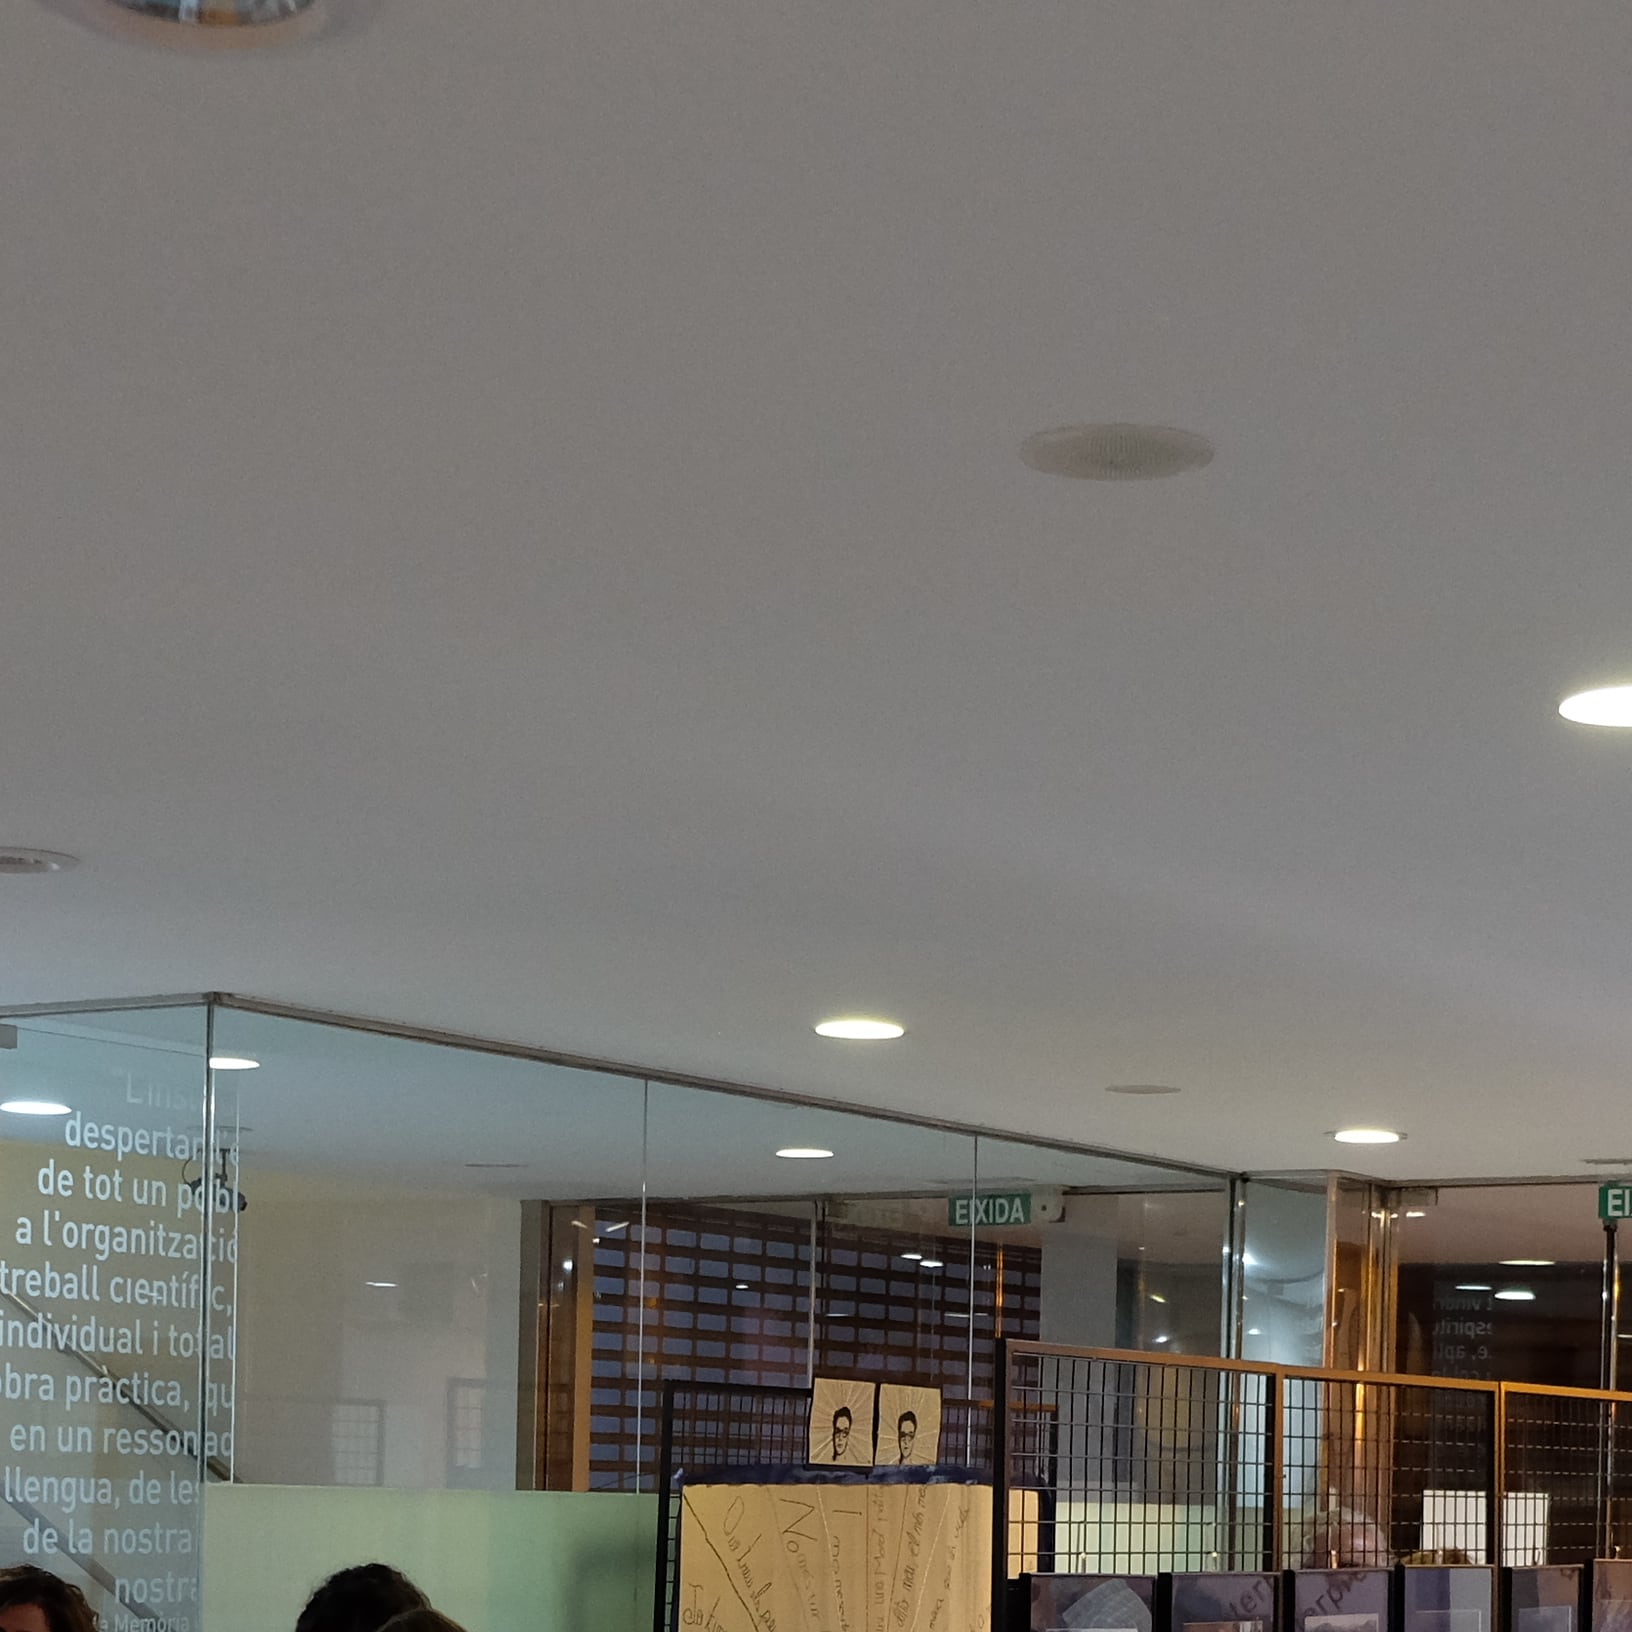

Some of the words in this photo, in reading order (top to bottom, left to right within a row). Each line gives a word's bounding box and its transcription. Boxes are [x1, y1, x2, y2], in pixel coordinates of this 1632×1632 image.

[37, 1158, 74, 1198] de
[82, 1165, 123, 1203] tot
[132, 1177, 166, 1207] un
[955, 1197, 1025, 1225] EIXIDA
[15, 1216, 32, 1245] a
[109, 1270, 233, 1317] científc,
[152, 1320, 159, 1356] i
[9, 1423, 46, 1452] en
[56, 1424, 93, 1454] un
[4, 1465, 121, 1514] llengua,
[128, 1469, 161, 1505] de
[23, 1517, 58, 1555] de
[68, 1517, 93, 1554] la
[103, 1521, 192, 1555] nostra
